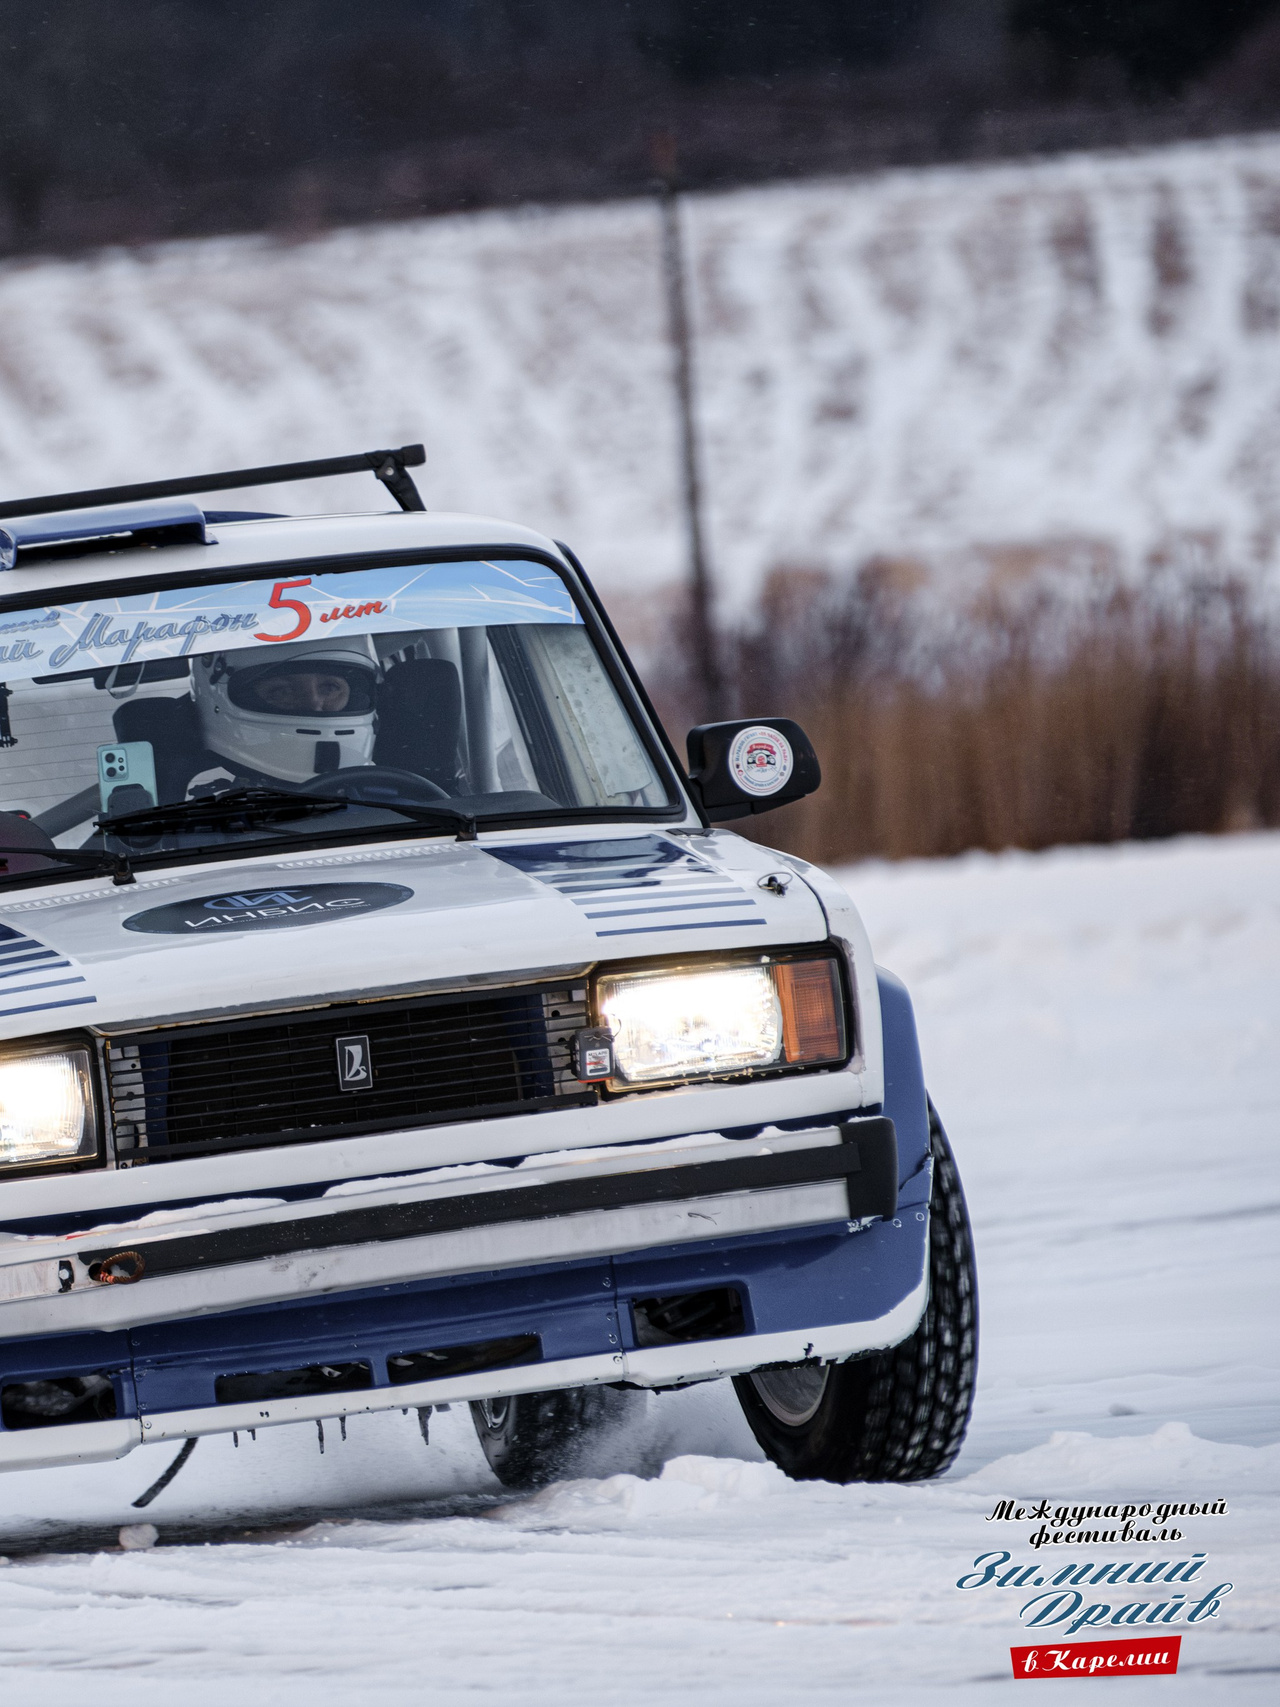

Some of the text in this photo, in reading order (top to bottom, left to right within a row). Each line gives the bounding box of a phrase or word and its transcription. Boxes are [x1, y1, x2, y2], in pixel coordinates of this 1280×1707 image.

[48, 611, 261, 668] Марафон
[253, 577, 313, 643] 5
[320, 600, 388, 624] лет
[184, 897, 367, 928] ИНБИС
